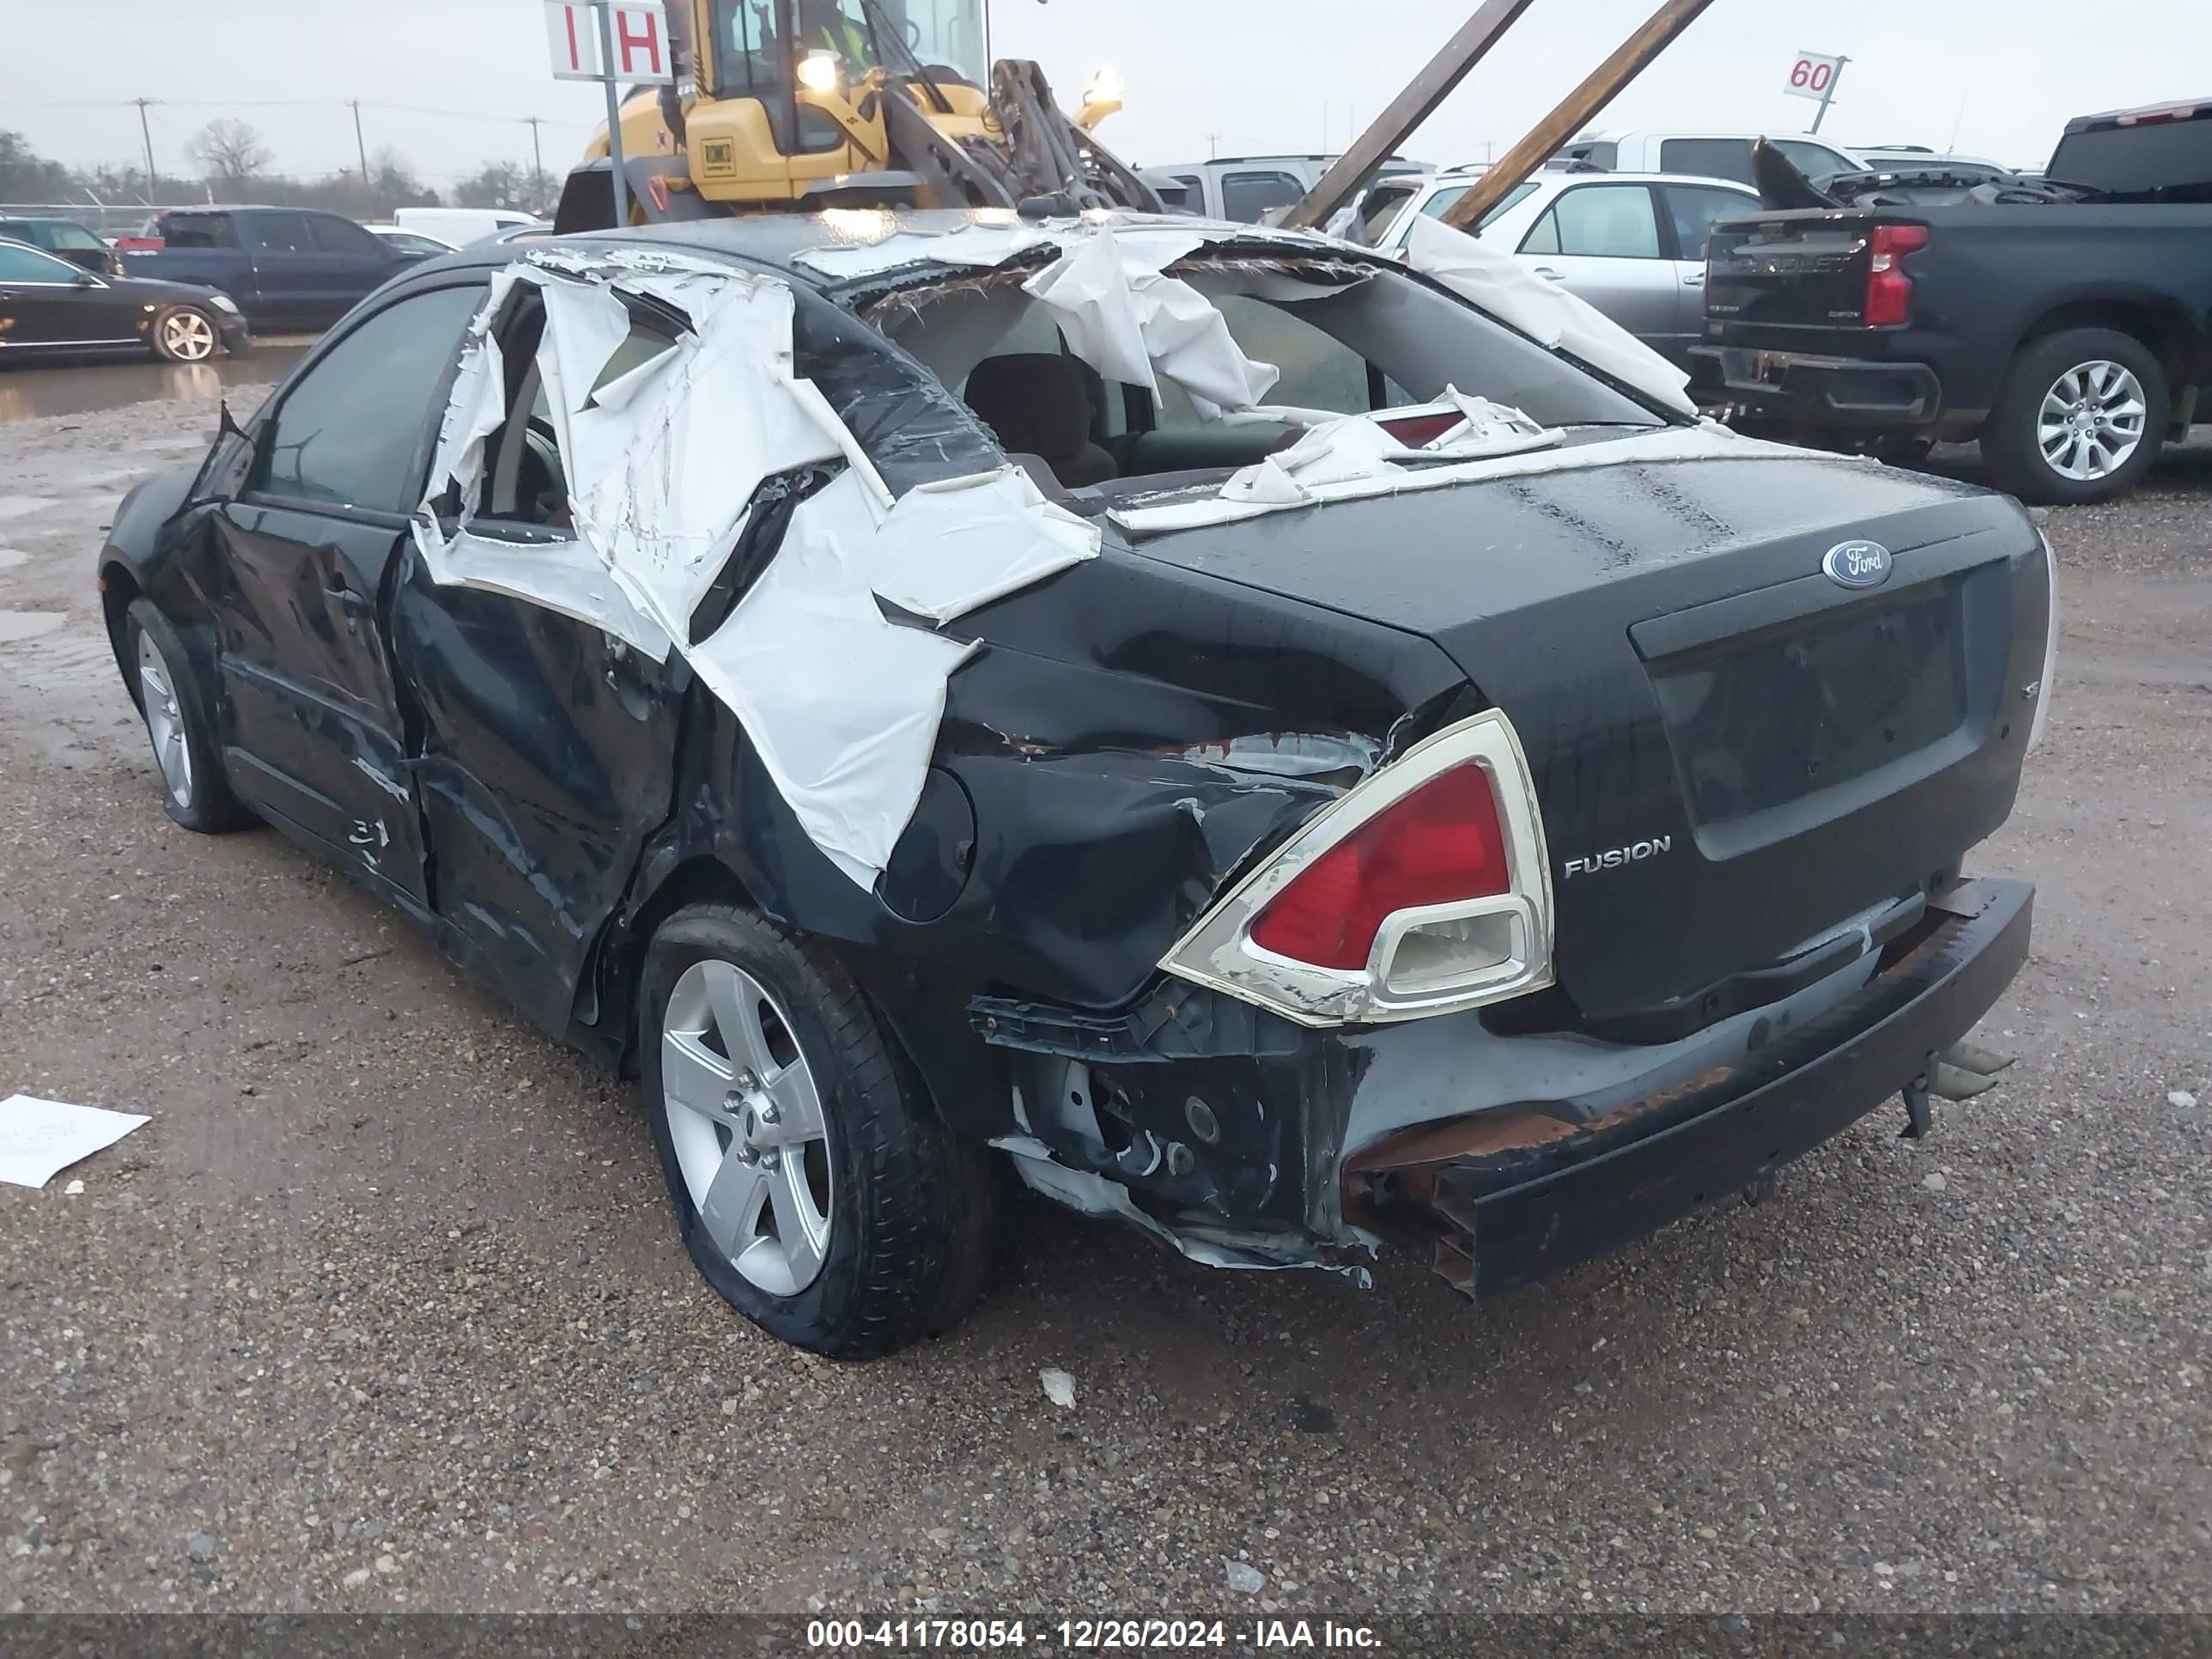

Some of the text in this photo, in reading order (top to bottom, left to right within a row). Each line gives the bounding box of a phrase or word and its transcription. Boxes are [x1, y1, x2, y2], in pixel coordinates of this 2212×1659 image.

[617, 10, 661, 74] H
[1790, 59, 1831, 91] 60
[1846, 546, 1883, 576] Ford
[1564, 835, 1671, 880] FUSION
